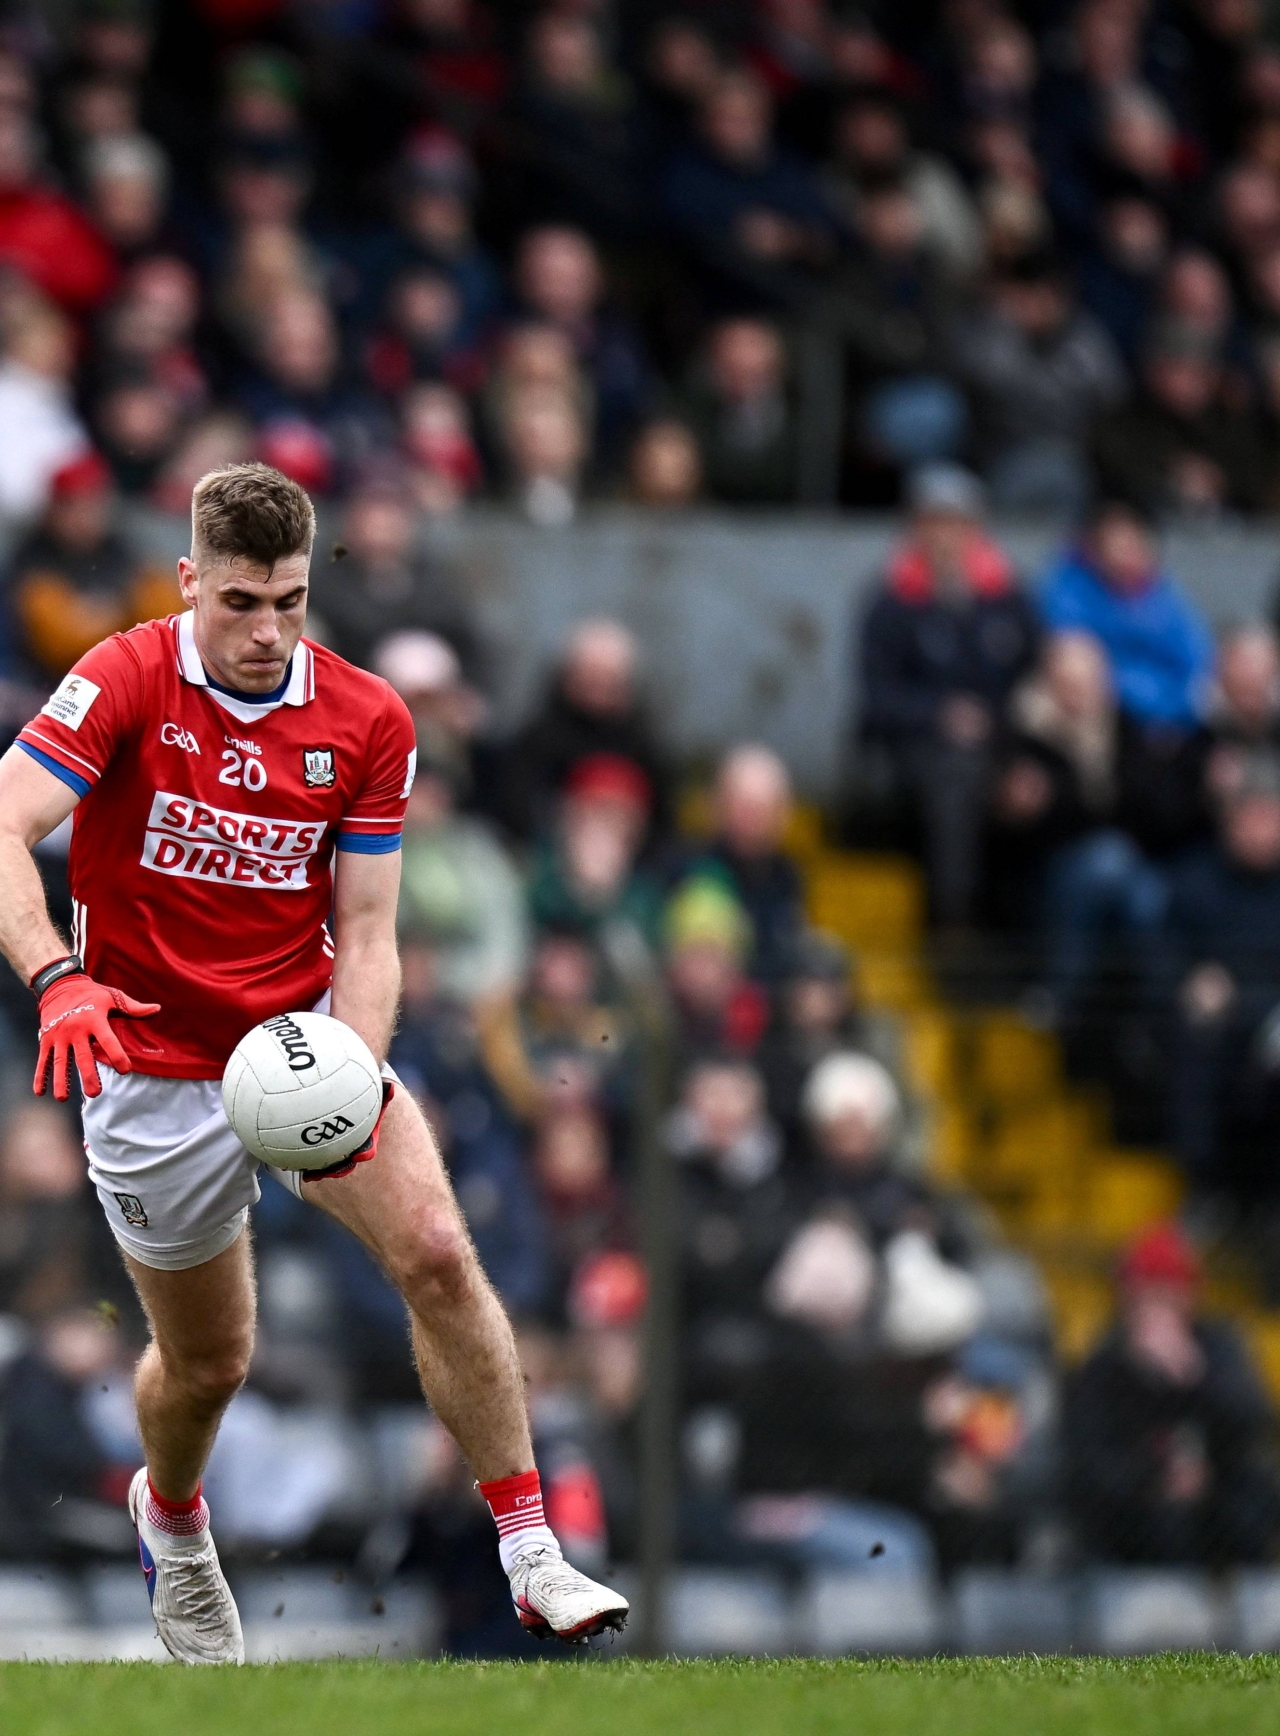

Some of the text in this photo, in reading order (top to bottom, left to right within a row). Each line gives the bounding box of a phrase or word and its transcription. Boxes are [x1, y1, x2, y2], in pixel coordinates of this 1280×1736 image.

[50, 700, 77, 717] nsurance
[218, 749, 268, 792] 20
[160, 799, 318, 854] SPORTS
[152, 838, 301, 886] DIRECT
